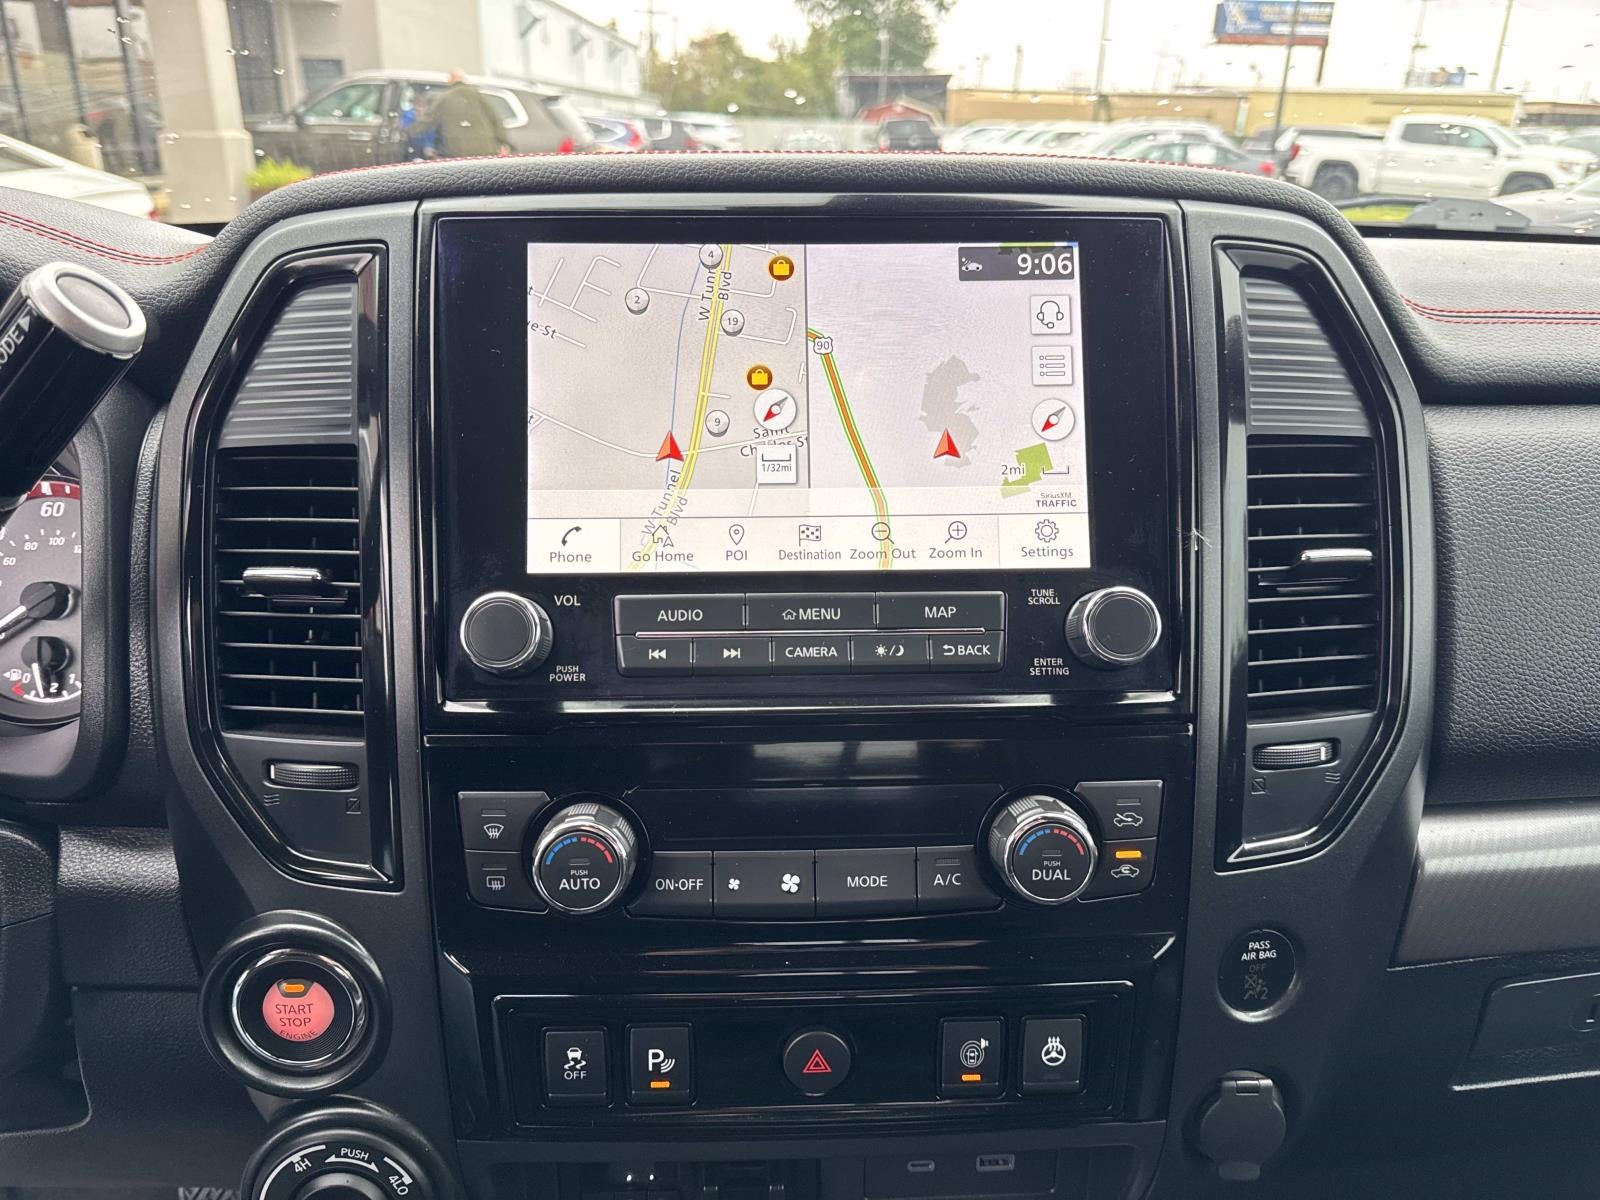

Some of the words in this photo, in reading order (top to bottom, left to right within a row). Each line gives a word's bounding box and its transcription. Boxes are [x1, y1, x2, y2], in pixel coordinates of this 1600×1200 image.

[707, 250, 714, 258] 4
[1017, 253, 1073, 275] 9:06
[718, 271, 732, 301] Blvd
[634, 296, 640, 305] 2
[698, 306, 710, 321] W
[727, 317, 738, 326] 19
[542, 325, 556, 339] St
[0, 330, 25, 363] ODE
[816, 341, 830, 350] 90
[715, 417, 721, 427] 9
[762, 464, 792, 472] 1/32mi
[1001, 464, 1025, 475] 2mi
[651, 469, 681, 517] Tunnel
[40, 501, 65, 517] 60
[1036, 499, 1077, 508] TRAFFIC
[666, 496, 688, 526] Blvd
[24, 542, 38, 551] 80
[49, 537, 65, 545] 100
[549, 552, 592, 563] Phone
[632, 552, 650, 562] Go
[655, 551, 694, 562] Home
[725, 550, 748, 561] POI
[778, 549, 842, 561] Destination
[850, 548, 888, 559] Zoom
[891, 548, 916, 559] Out
[928, 547, 967, 559] Zoom
[971, 547, 983, 558] In
[1021, 546, 1074, 560] Settings
[2, 557, 16, 566] 60
[554, 595, 581, 606] VOL
[1028, 597, 1061, 605] SCROLL
[657, 609, 703, 622] AUDIO
[799, 608, 841, 621] MENU
[924, 606, 957, 618] MAP
[785, 647, 838, 658] CAMERA
[958, 645, 991, 656] BACK
[1033, 658, 1064, 667] ENTER
[556, 665, 579, 673] PUSH
[1029, 667, 1070, 676] SETTING
[549, 673, 586, 682] POWER
[933, 873, 961, 887] A/C
[1031, 869, 1071, 882] DUAL
[559, 878, 600, 890] AUTO
[847, 876, 888, 888] MODE
[1248, 940, 1271, 950] PASS
[1241, 951, 1257, 961] AIR
[1258, 950, 1277, 960] BAG
[275, 1003, 314, 1015] START
[279, 1017, 311, 1027] STOP
[279, 1029, 318, 1040] ENGINE
[564, 1071, 587, 1080] OFF
[340, 1147, 369, 1161] PUSH
[293, 1158, 312, 1174] 4H
[388, 1174, 409, 1196] 4LO
